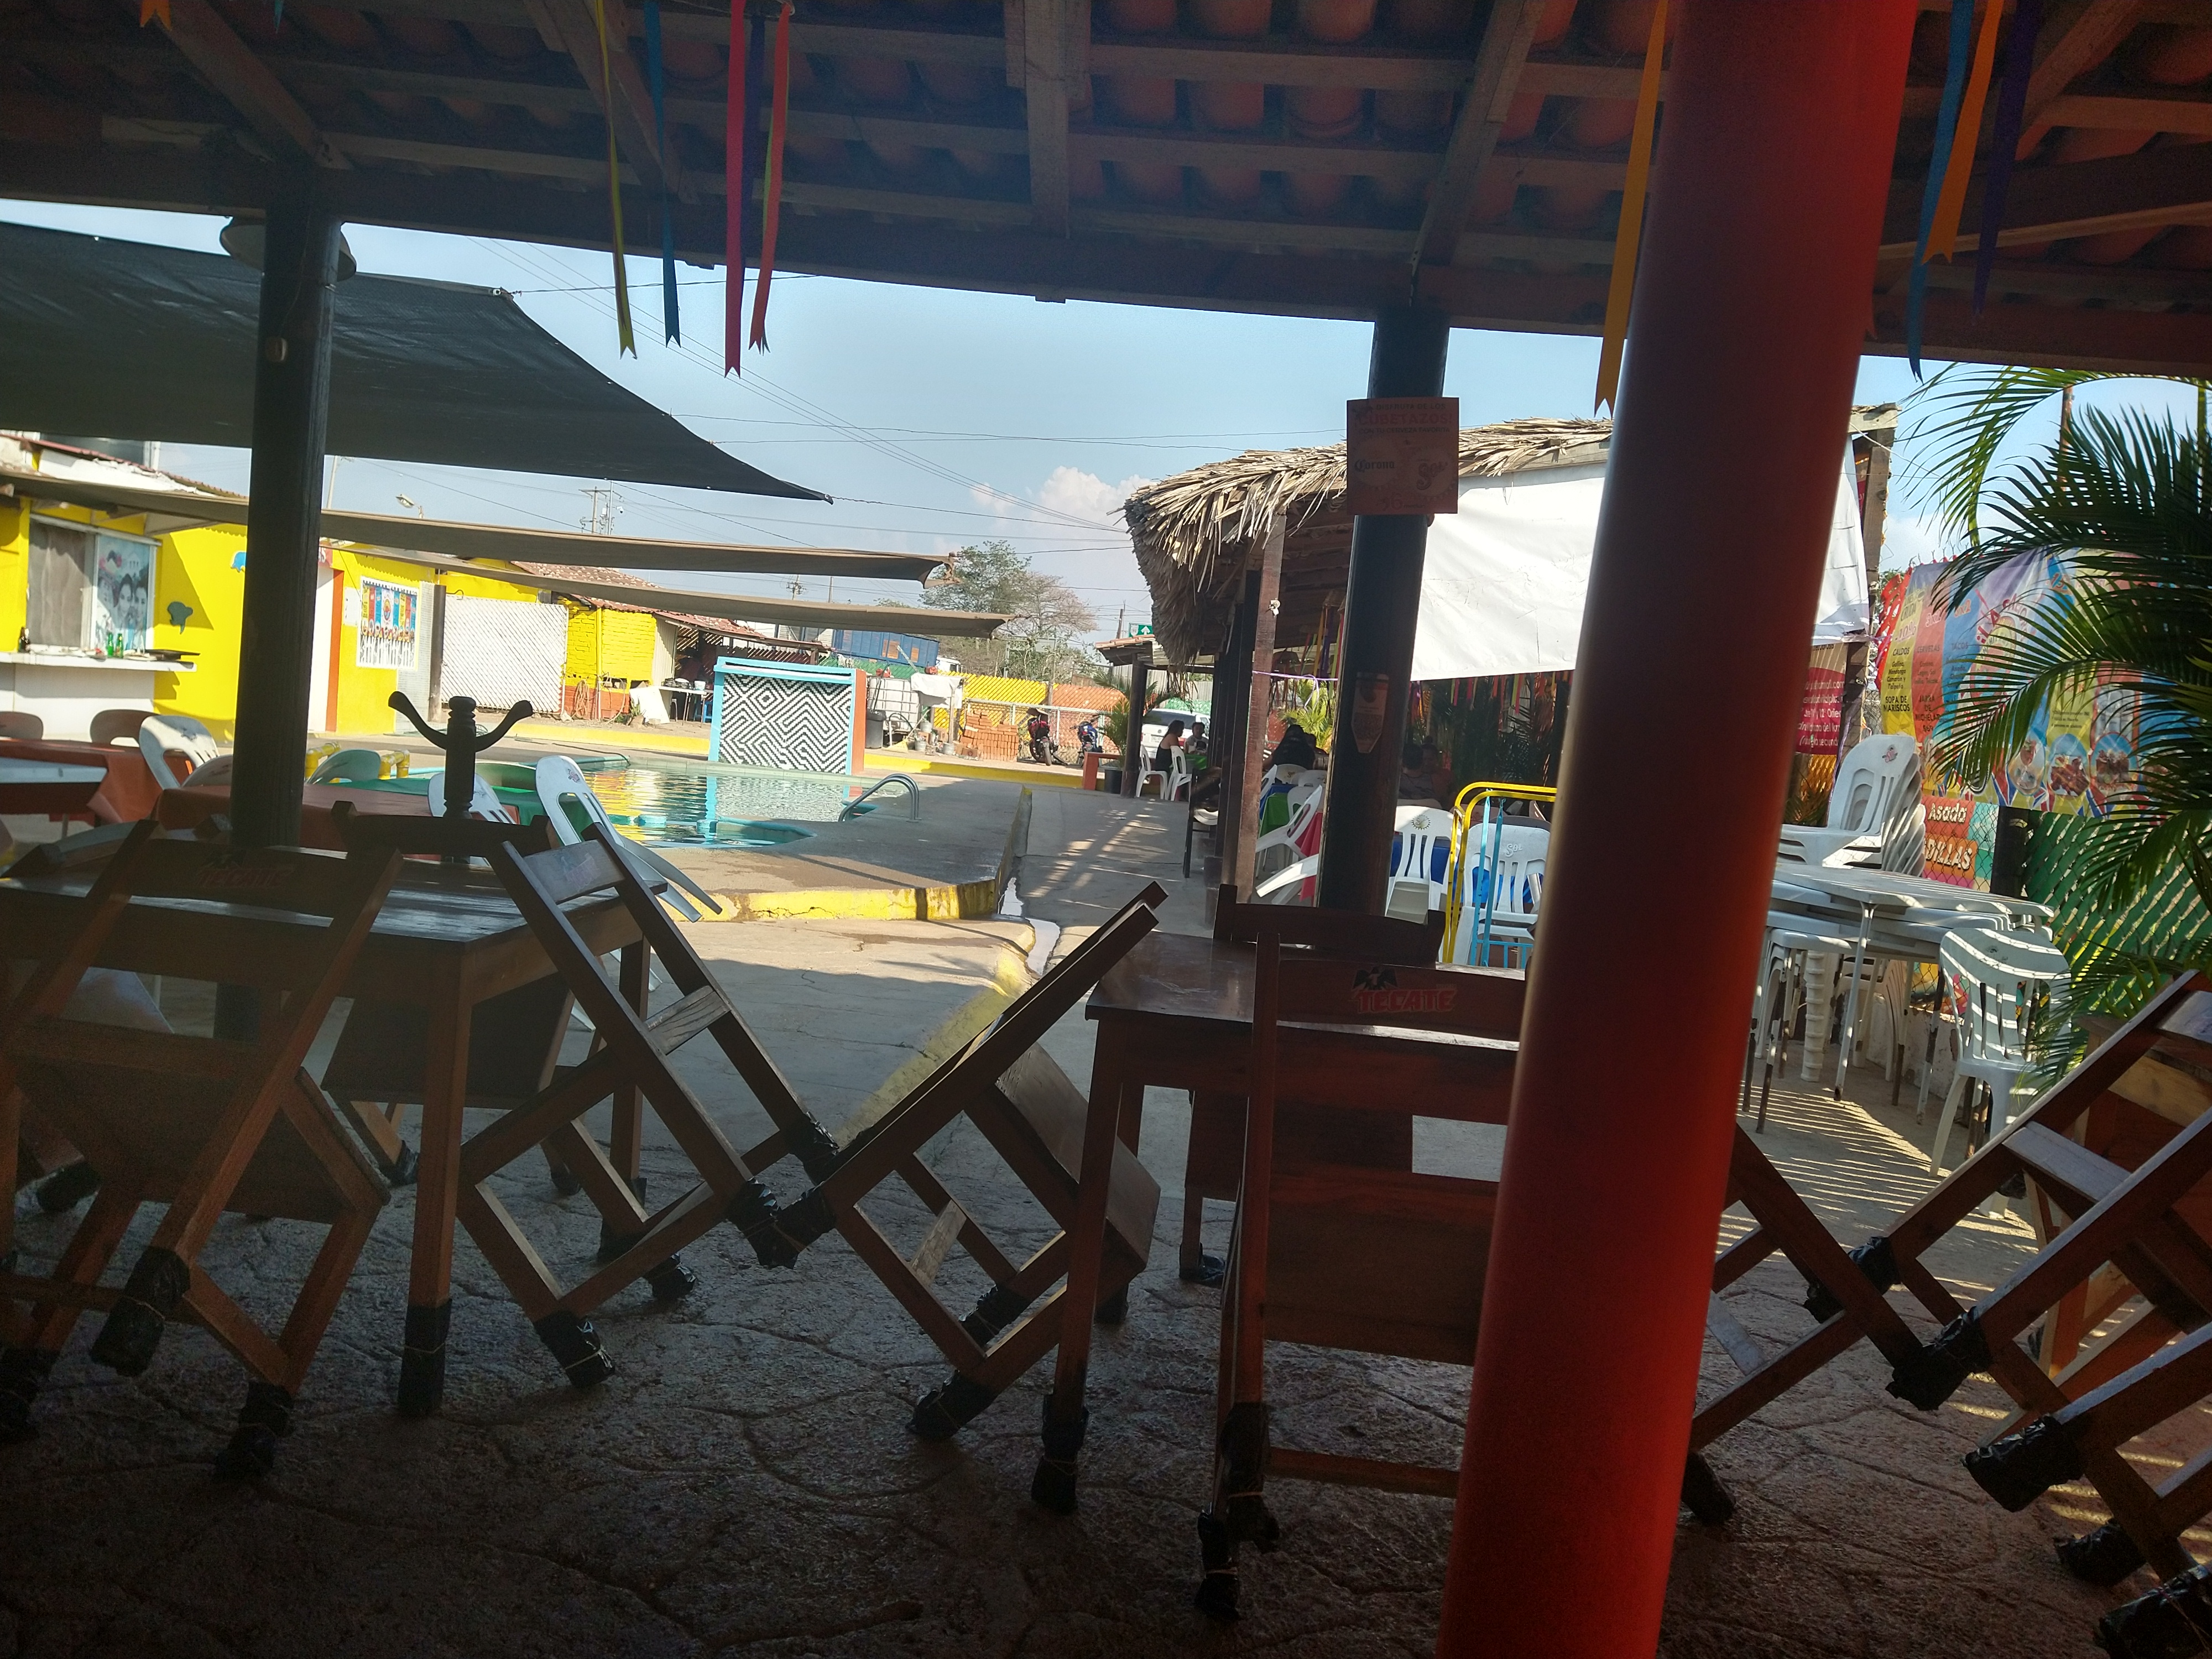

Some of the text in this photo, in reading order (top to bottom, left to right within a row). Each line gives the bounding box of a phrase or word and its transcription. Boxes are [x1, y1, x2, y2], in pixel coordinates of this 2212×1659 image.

[1354, 460, 1395, 472] Corona
[1892, 647, 1910, 656] CALDOS
[1883, 703, 1911, 712] MARISCOS
[1823, 722, 1831, 732] del
[1819, 737, 1839, 747] secund
[1928, 802, 1968, 823] Asada
[1924, 838, 1974, 871] DILLAS
[1358, 988, 1457, 1014] TECATE
